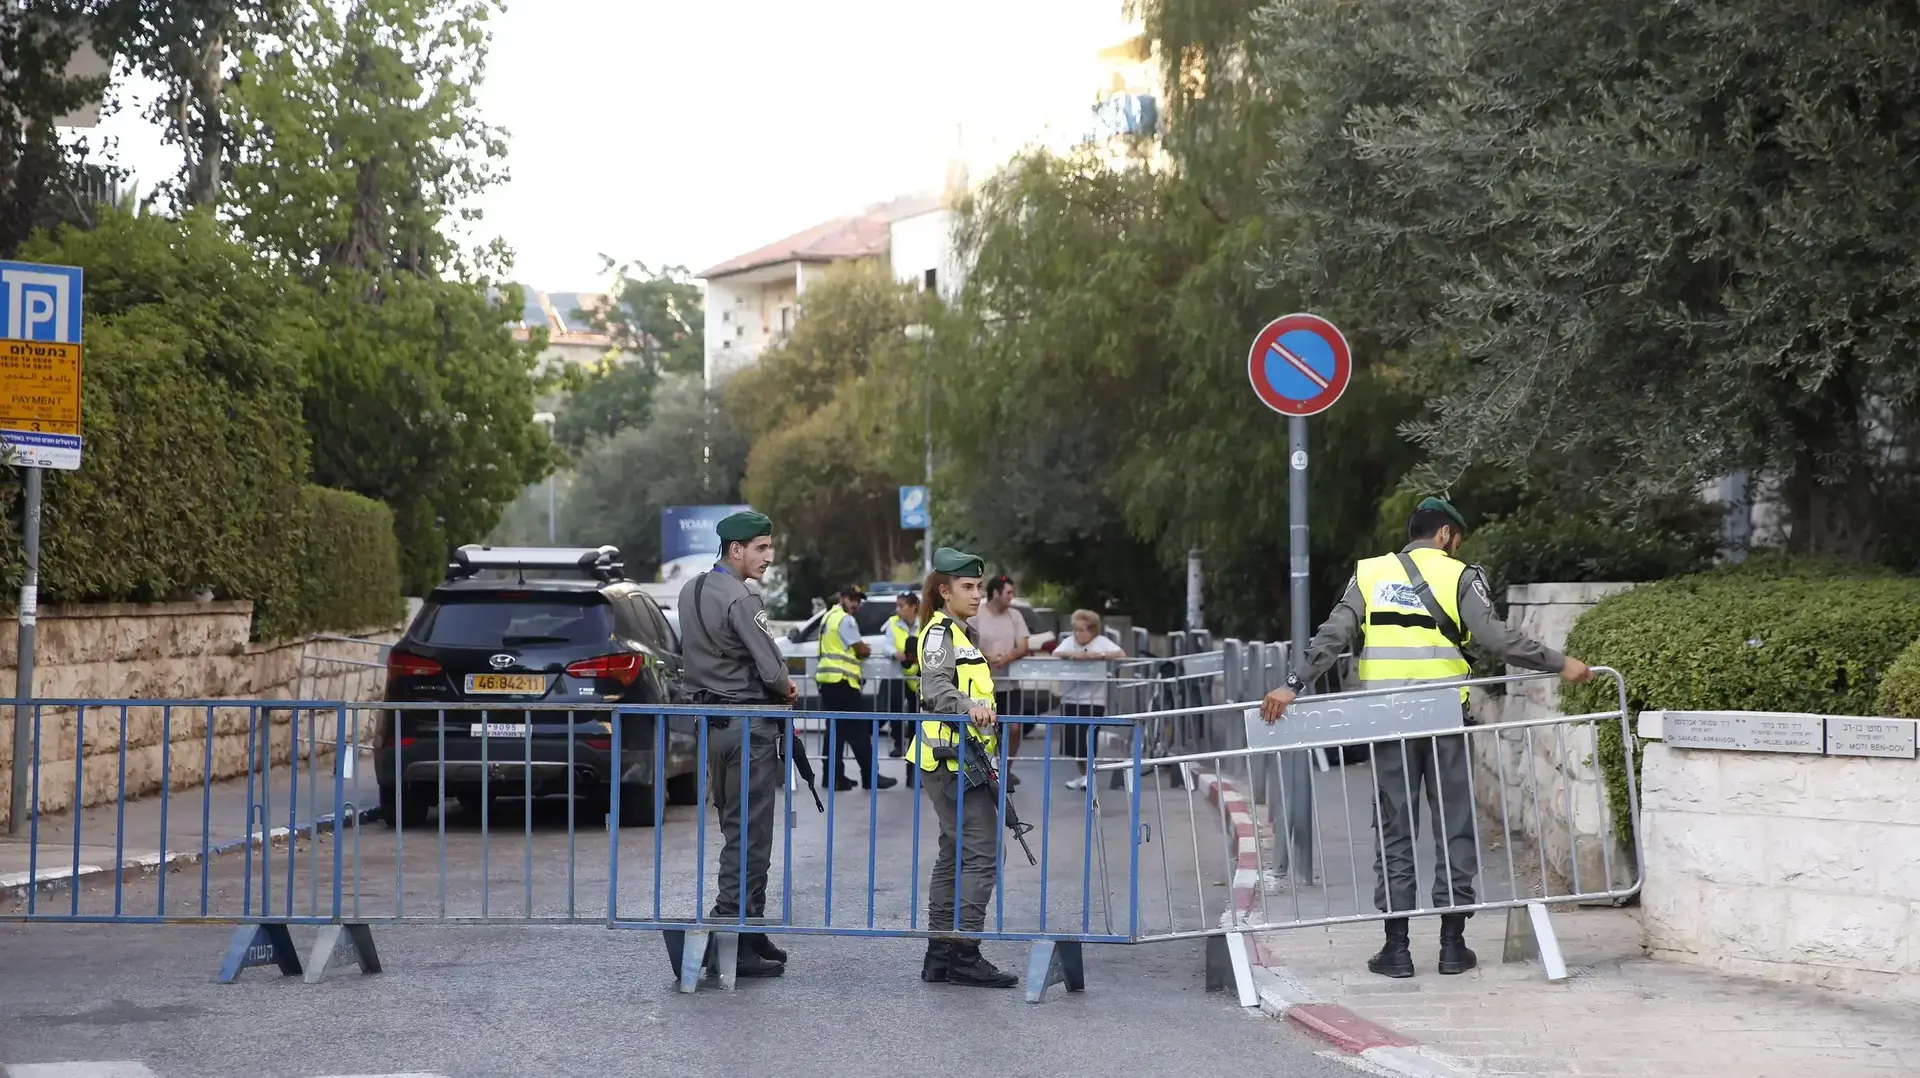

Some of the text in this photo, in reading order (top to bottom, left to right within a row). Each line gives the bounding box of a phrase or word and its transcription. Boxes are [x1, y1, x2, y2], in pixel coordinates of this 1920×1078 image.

[26, 290, 54, 340] P
[10, 343, 66, 357] בתשלום
[12, 395, 63, 405] PAYMENT
[31, 421, 40, 431] 3
[1849, 743, 1868, 751] MOTI
[1870, 743, 1906, 752] BEN-DOV
[249, 944, 273, 962] קשת
